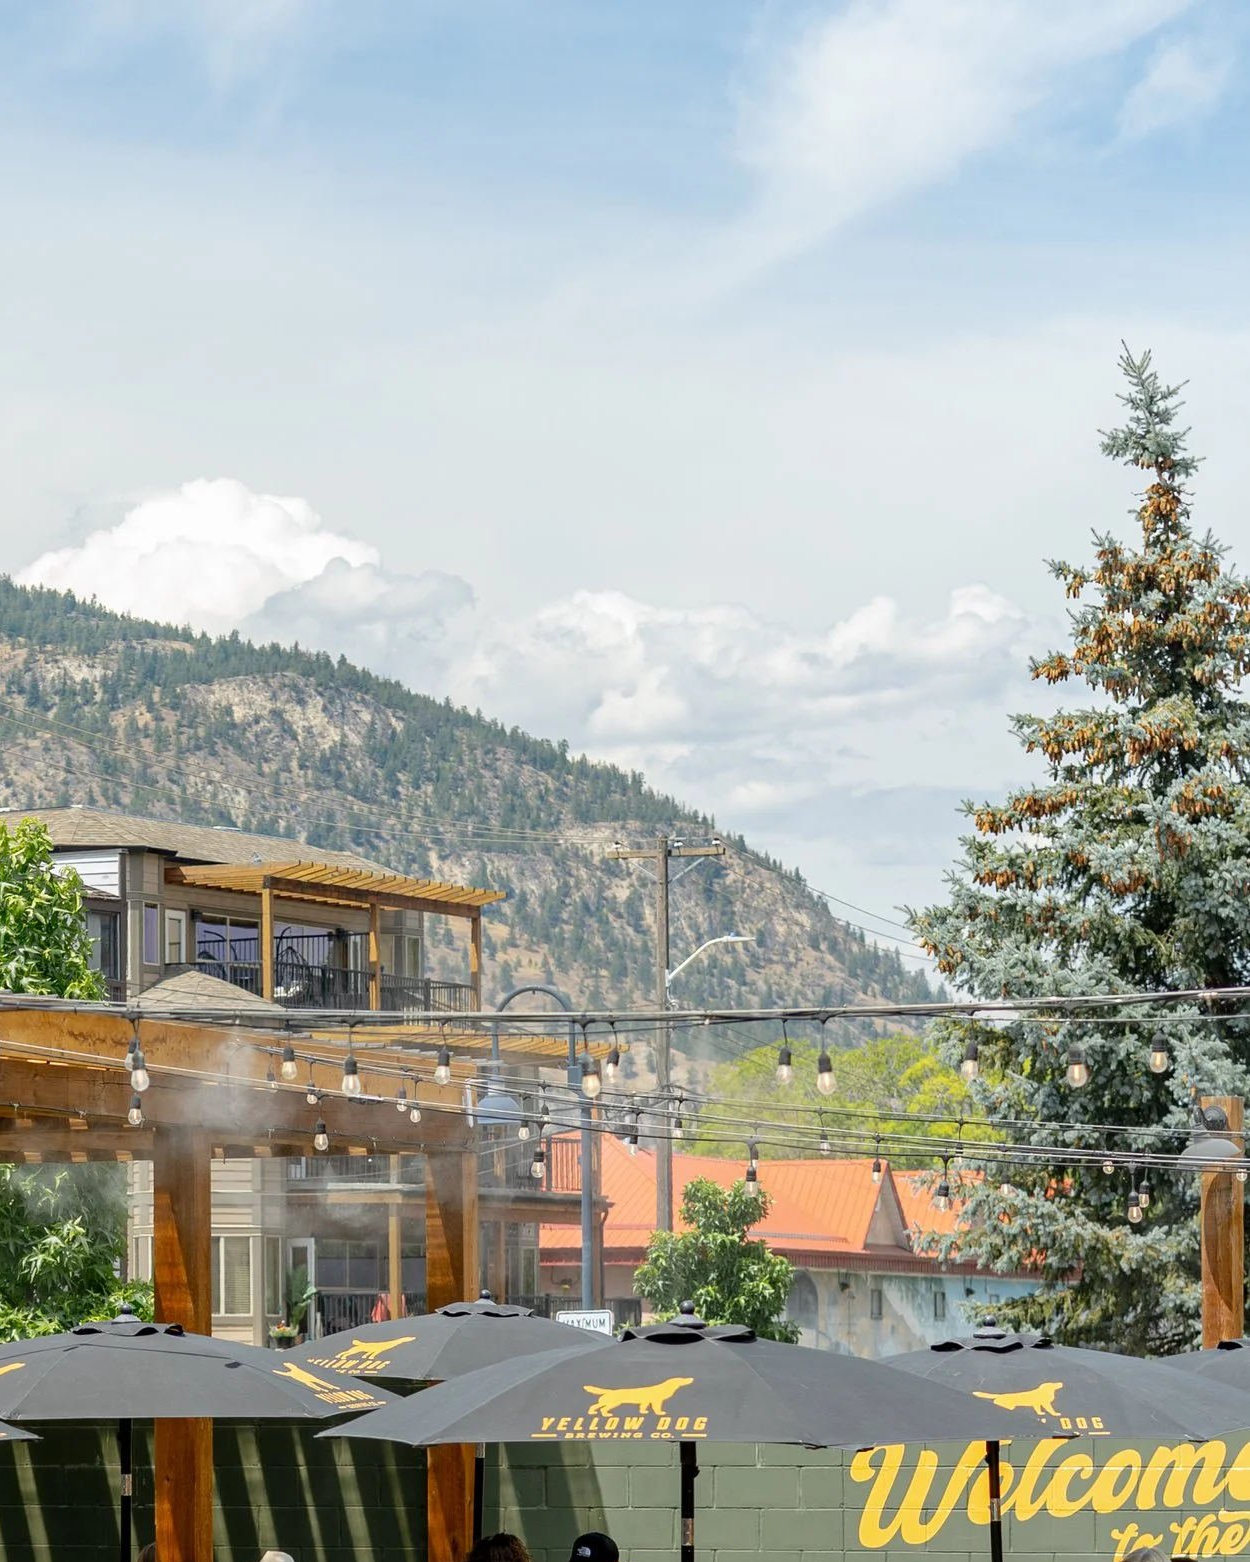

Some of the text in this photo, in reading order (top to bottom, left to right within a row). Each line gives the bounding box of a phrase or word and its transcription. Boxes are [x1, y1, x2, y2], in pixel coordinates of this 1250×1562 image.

[562, 1317, 606, 1329] AXIMUM
[541, 1416, 708, 1431] YELLOW DOG
[1059, 1416, 1104, 1430] DOG
[1170, 1507, 1250, 1560] the
